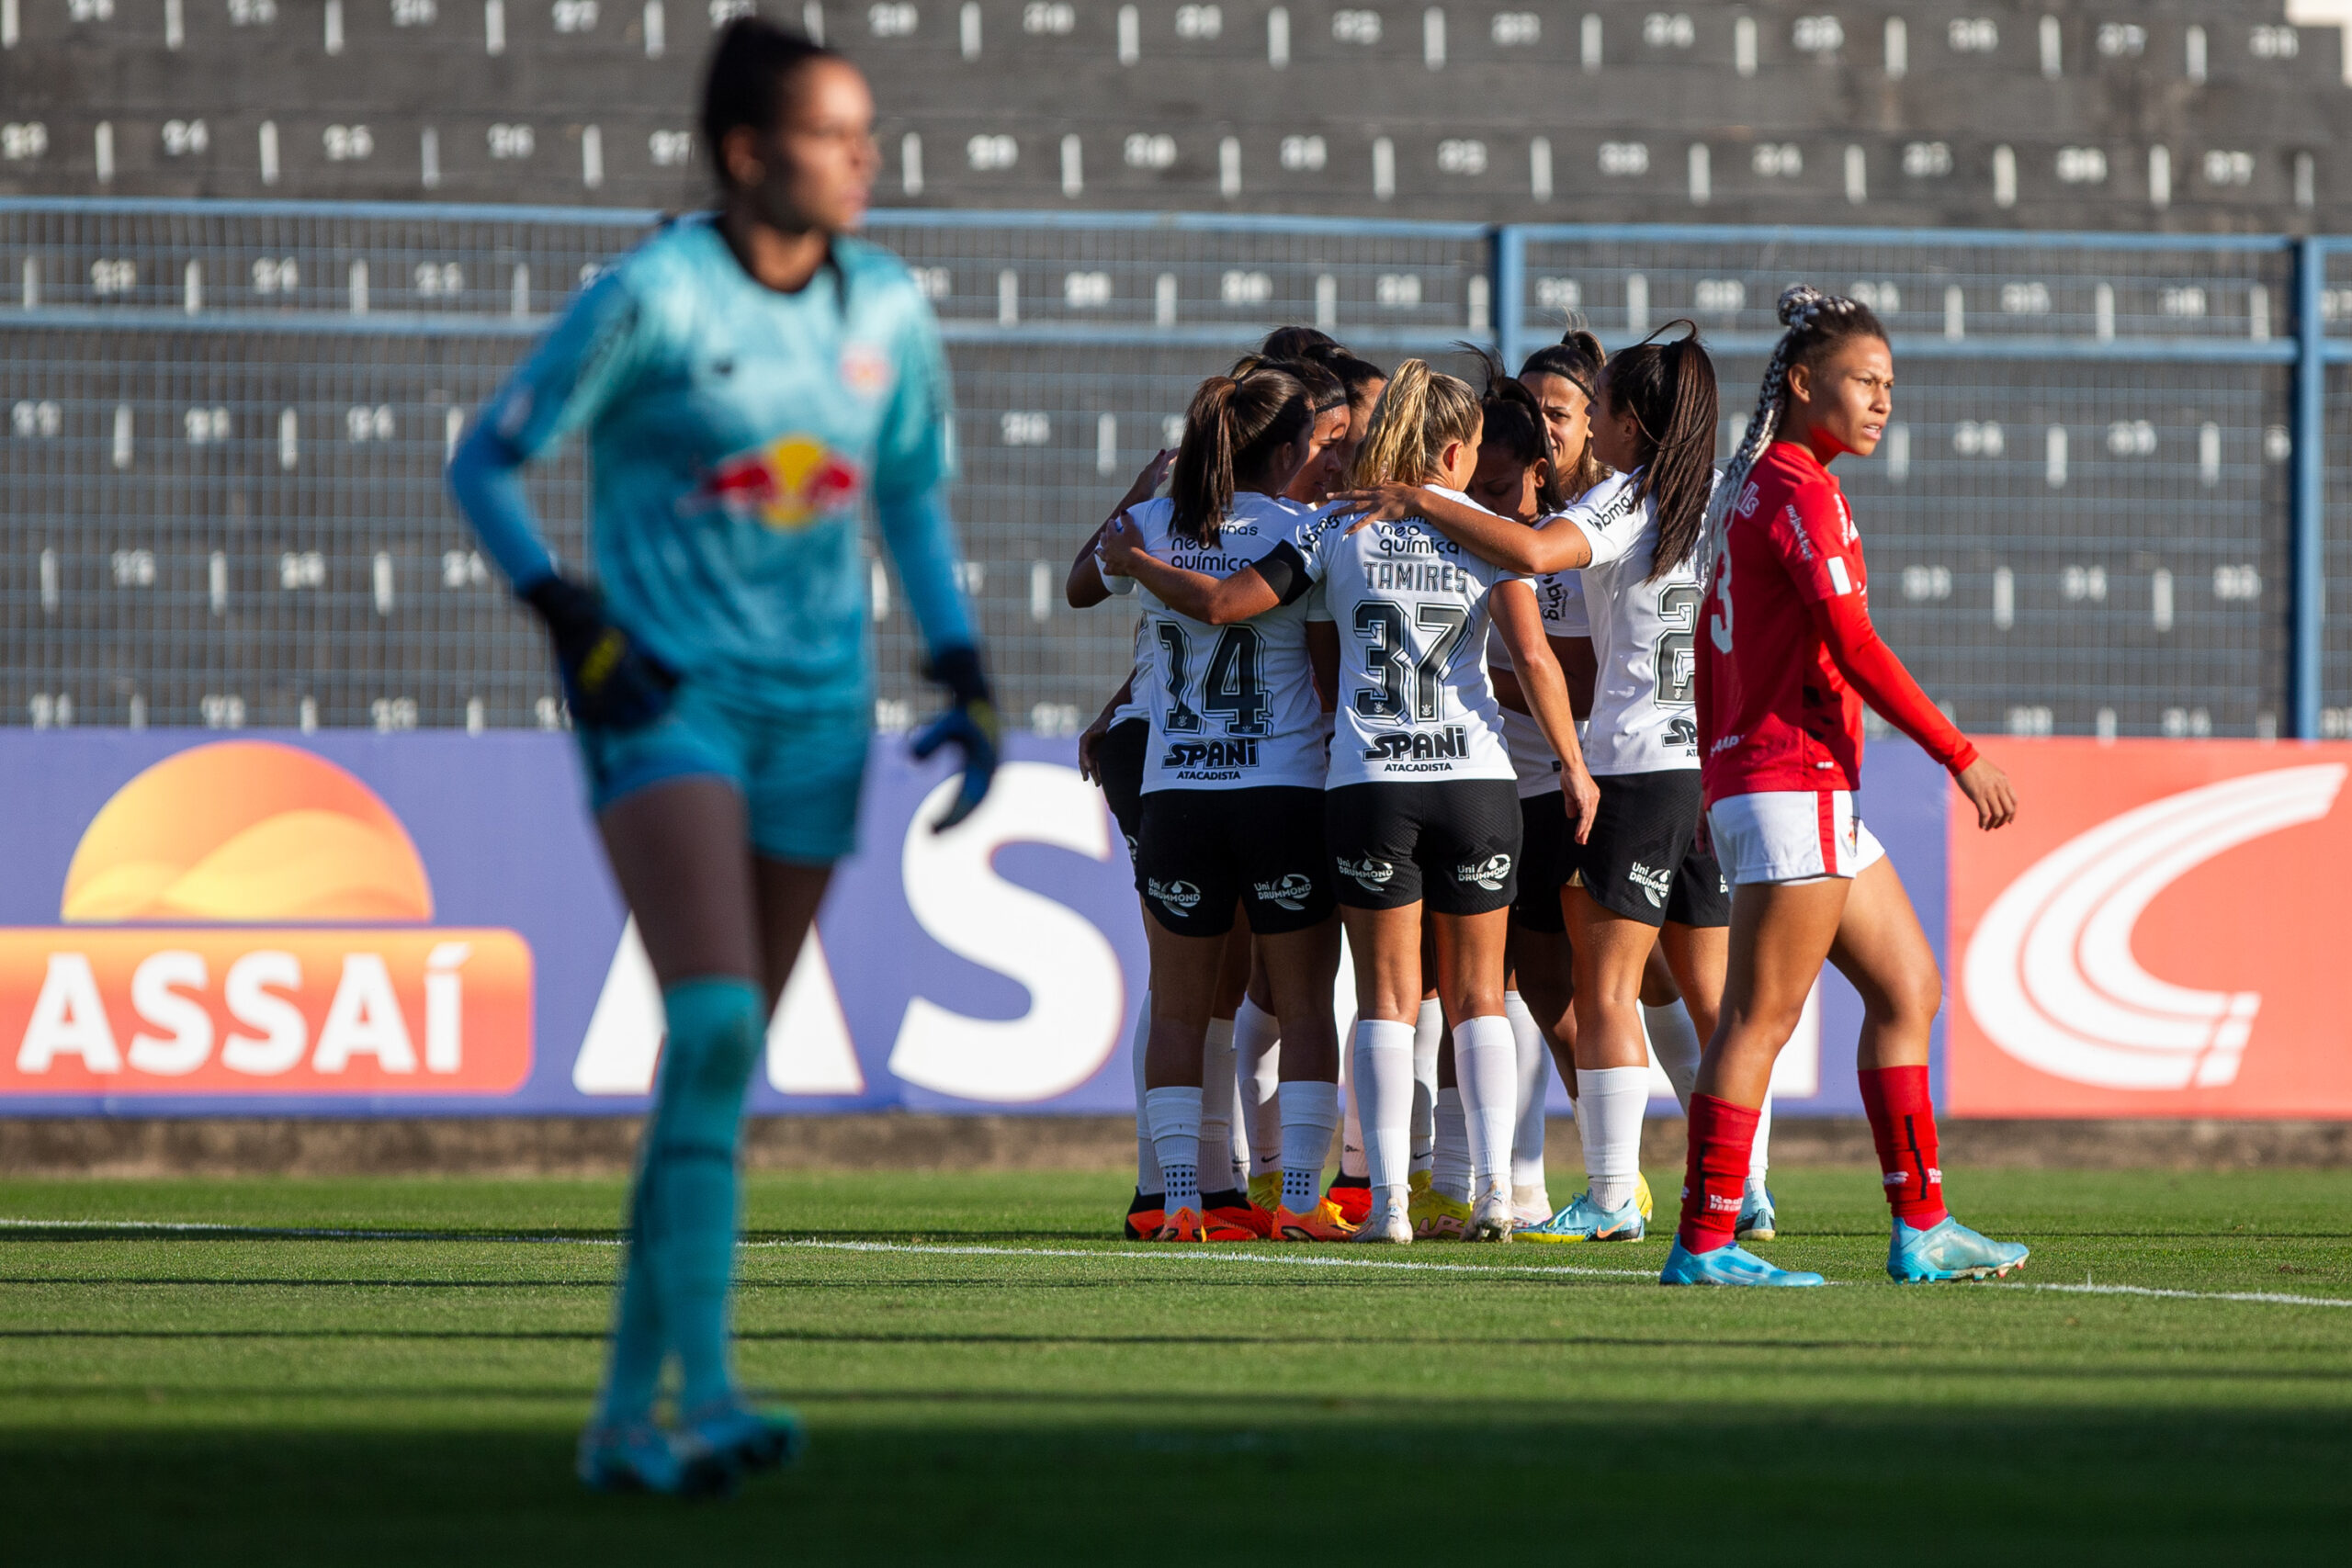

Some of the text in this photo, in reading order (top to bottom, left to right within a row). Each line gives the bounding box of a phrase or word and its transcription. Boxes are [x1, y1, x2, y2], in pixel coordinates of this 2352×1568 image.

[1381, 525, 1421, 537] neo
[1379, 536, 1459, 557] química
[1363, 561, 1468, 593] TAMIRES
[1352, 599, 1475, 727] 37
[1156, 620, 1274, 739] 14
[1384, 762, 1453, 772] ATACADISTA
[1176, 770, 1241, 780] ATACADISTA
[1337, 856, 1351, 868] Uni
[1457, 863, 1476, 874] Uni
[1632, 862, 1650, 875] Uni
[1339, 866, 1394, 878] DRUMMOND
[1458, 862, 1511, 882] DRUMMOND
[1148, 877, 1160, 890] Uni
[1254, 881, 1271, 891] Uni
[1148, 887, 1201, 902] DRUMMOND
[1258, 883, 1312, 900] DRUMMOND
